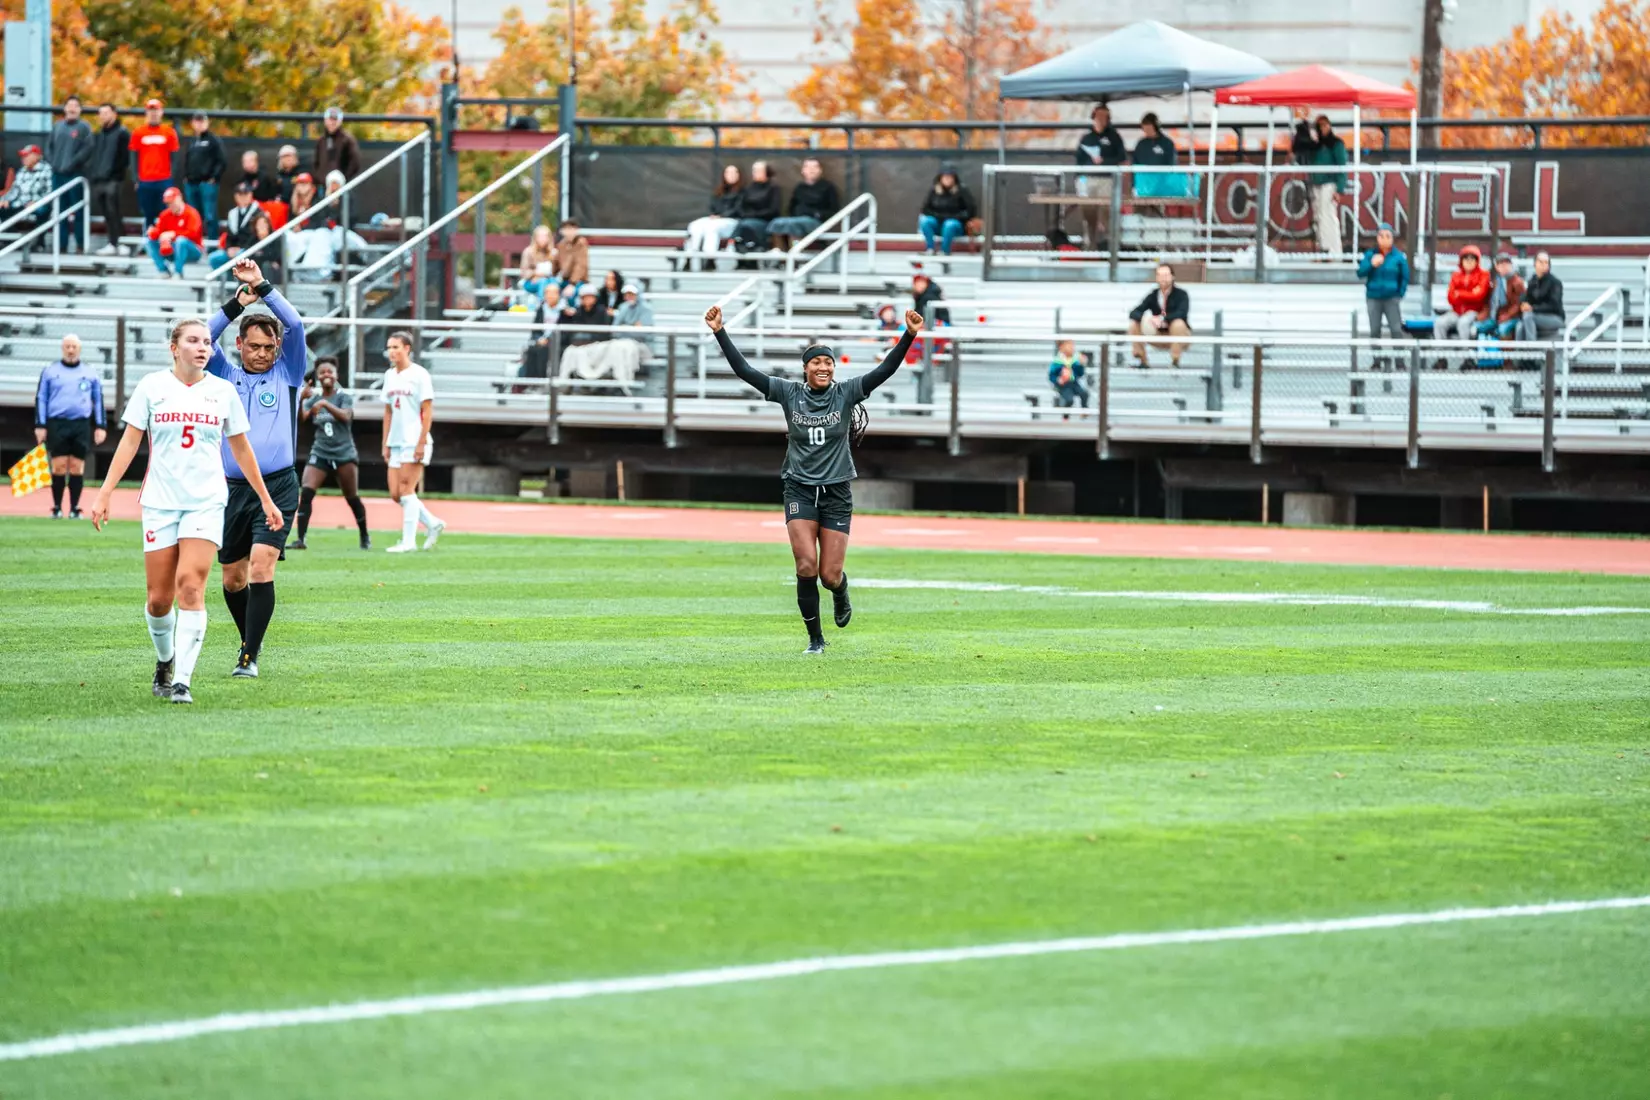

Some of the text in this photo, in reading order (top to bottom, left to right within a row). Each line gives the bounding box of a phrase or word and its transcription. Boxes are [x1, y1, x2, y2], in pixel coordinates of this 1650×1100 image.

[1213, 161, 1586, 236] CORNELL
[154, 412, 219, 426] CORNELL
[792, 410, 841, 426] BROWN
[181, 425, 195, 449] 5
[807, 426, 826, 446] 10
